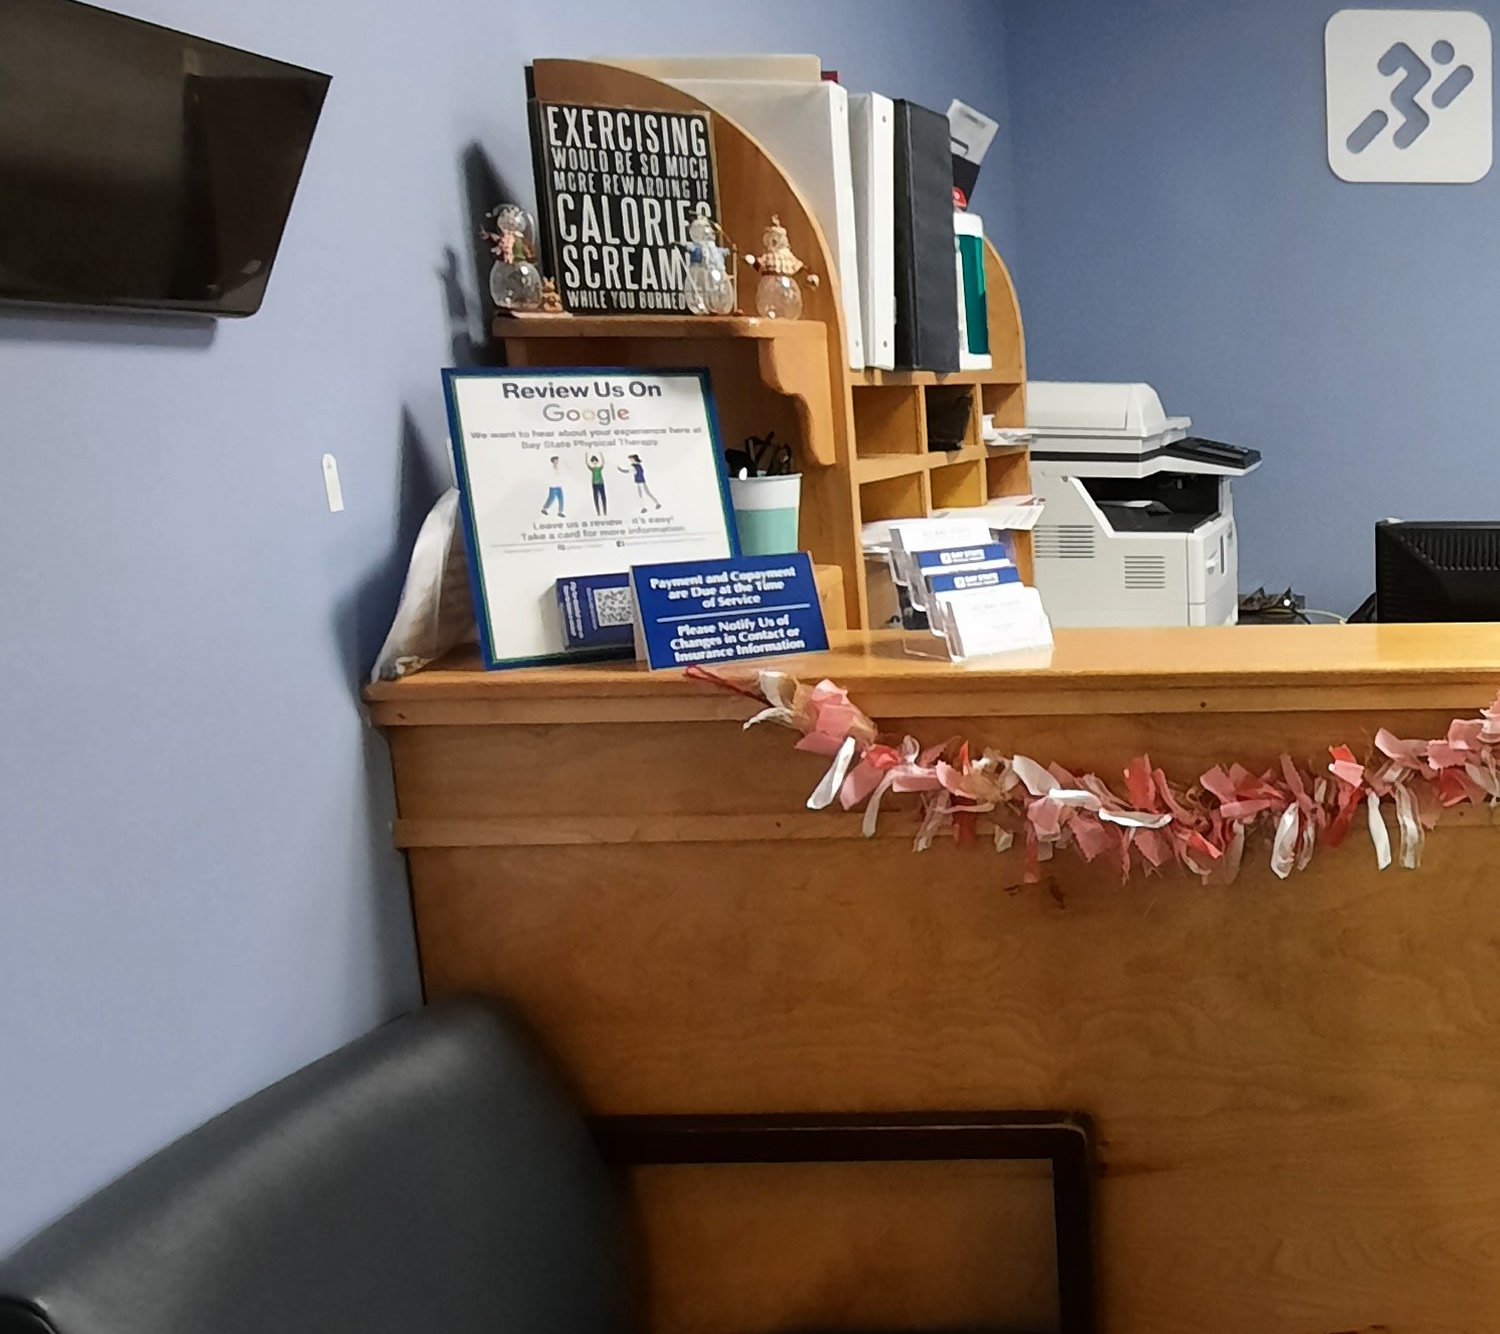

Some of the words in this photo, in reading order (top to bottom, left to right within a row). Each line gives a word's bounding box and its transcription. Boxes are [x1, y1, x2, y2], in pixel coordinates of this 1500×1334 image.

[546, 106, 707, 157] EXERCISING
[551, 147, 609, 173] WOULD
[614, 151, 634, 175] BE
[639, 153, 660, 177] SO
[665, 155, 708, 180] MUCH
[553, 170, 596, 194] MORE
[602, 173, 691, 200] REWARDING
[696, 180, 708, 200] IF
[562, 244, 691, 291] SCREAM
[566, 290, 608, 309] WHILE
[611, 291, 636, 310] YOU
[639, 291, 686, 311] BURNED
[502, 382, 589, 399] Review
[594, 381, 624, 398] Us
[629, 380, 662, 398] On
[543, 403, 630, 425] Google
[518, 430, 530, 438] to
[521, 440, 541, 450] Bay
[544, 440, 571, 448] State
[573, 439, 616, 449] Physical
[521, 532, 546, 542] Take
[557, 530, 581, 539] card
[583, 528, 597, 538] for
[599, 528, 626, 537] more
[533, 522, 563, 531] Leave
[566, 521, 580, 529] us
[589, 518, 623, 527] review
[649, 574, 703, 591] Payment
[705, 571, 729, 584] and
[730, 567, 796, 583] Copayment
[668, 589, 689, 600] are
[691, 586, 716, 598] Due
[719, 584, 732, 595] at
[733, 582, 753, 593] the
[755, 579, 785, 591] Time
[702, 598, 716, 609] of
[717, 594, 761, 607] Service
[677, 623, 716, 637] Please
[719, 619, 755, 634] Notify
[758, 617, 775, 628] Us
[776, 614, 790, 627] of
[670, 636, 723, 651] Changes
[724, 632, 737, 644] in
[738, 628, 785, 642] Contact
[786, 627, 800, 637] or
[674, 648, 734, 663] Insurance
[736, 638, 806, 655] Information
